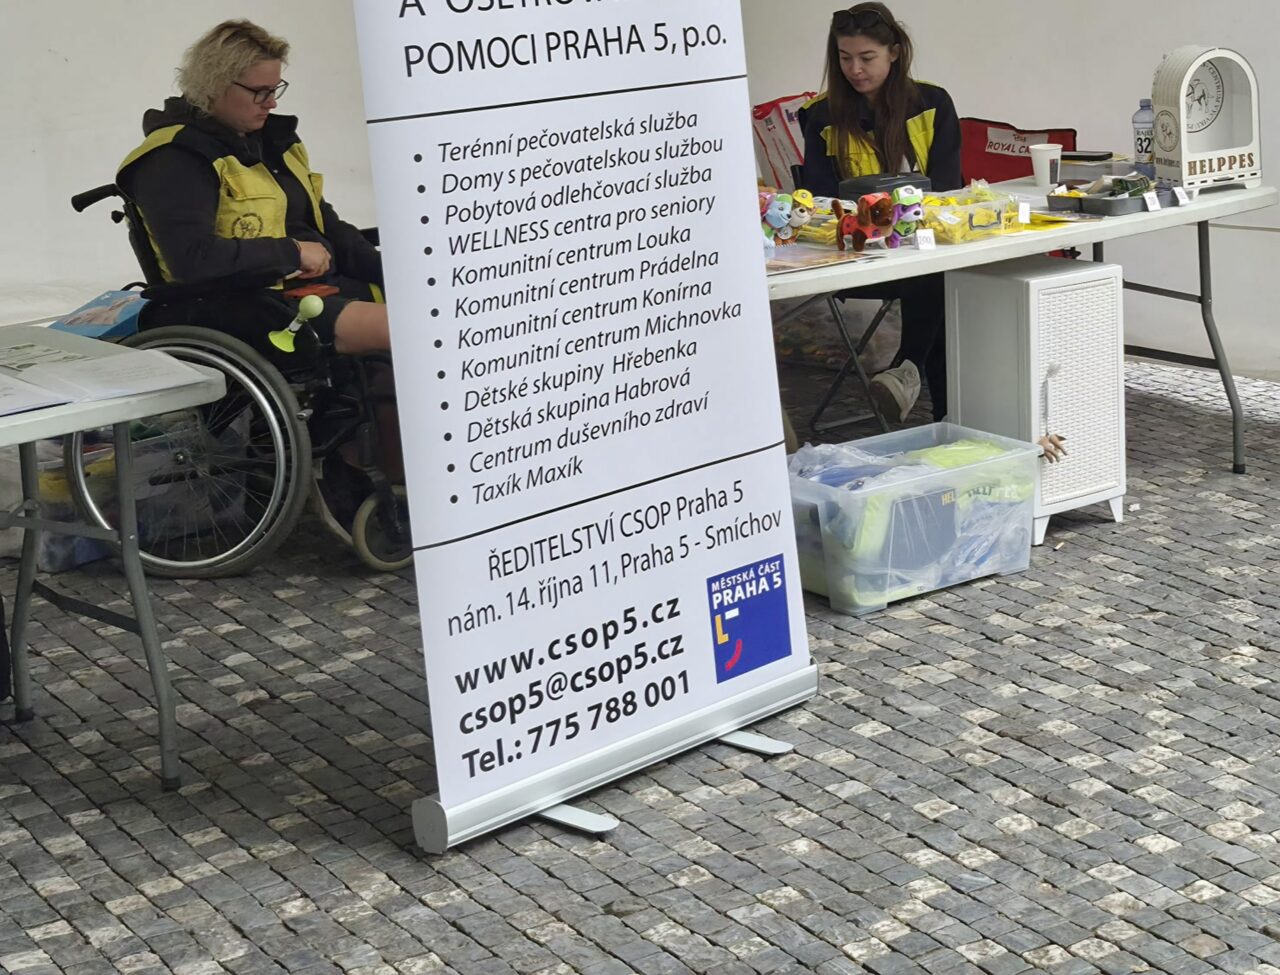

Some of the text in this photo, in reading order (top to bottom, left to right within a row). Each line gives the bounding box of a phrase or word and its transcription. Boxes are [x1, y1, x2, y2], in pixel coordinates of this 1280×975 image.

[404, 22, 726, 77] POMOCI PRAHA 5, p.o.
[438, 111, 697, 162] Terénní pečovatelská služba
[442, 137, 723, 194] Domy s pečovatelskou službou
[987, 141, 1016, 153] ROYAL
[1188, 152, 1255, 176] HELPPES
[445, 165, 712, 225] Pobytová odlehčovací služba
[448, 196, 715, 256] WELLNESS centra pro seniory
[452, 225, 691, 287] Komunitní centrum Louka
[455, 250, 718, 318] Komunitní centrum Prádelna
[458, 281, 711, 349] Komunitní centrum Konírna
[461, 301, 741, 380] Komunitní centrum Michnovka
[464, 339, 697, 412] Dětské skupiny Hřebenka
[467, 367, 690, 443] Dětská skupina Habrová
[470, 391, 709, 473] Centrum duševního zdraví
[472, 455, 583, 504] Taxík Maxík
[488, 480, 743, 581] ŘEDITELSTVÍ CSOP Praha 5
[448, 604, 501, 636] nám.
[505, 591, 535, 616] 14.
[538, 564, 584, 605] října
[590, 560, 616, 589] 11,
[621, 543, 674, 578] Praha
[680, 534, 689, 559] 5
[705, 510, 781, 550] Smíchov
[712, 560, 780, 592] MĚSTSKÁ ČÁST
[712, 572, 782, 610] PRAHA 5
[455, 597, 680, 694] www.csop5.cz
[459, 634, 684, 734] csop5@csop5.cz
[462, 670, 689, 778] Tel.: 775 788 001
